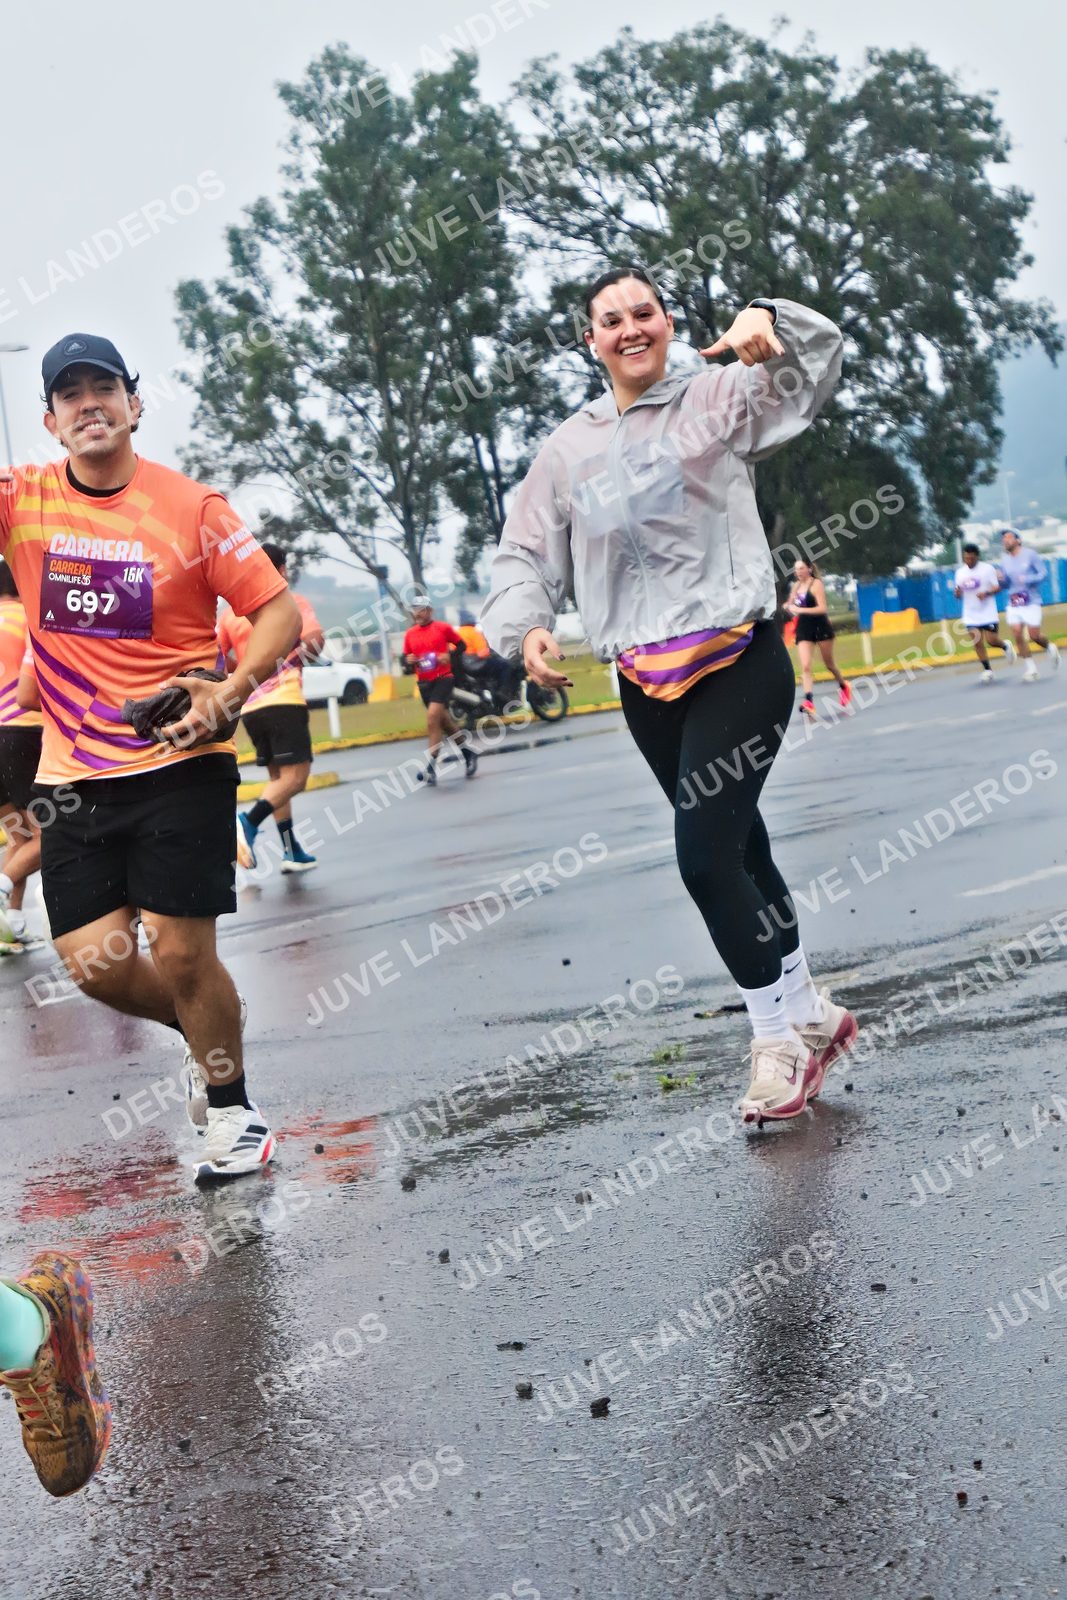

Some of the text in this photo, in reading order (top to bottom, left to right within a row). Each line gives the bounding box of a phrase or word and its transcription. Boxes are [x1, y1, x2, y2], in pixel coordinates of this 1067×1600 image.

[49, 533, 143, 562] CARRERA
[49, 559, 92, 576] CARRERA
[123, 567, 145, 583] 15K
[66, 589, 115, 615] 697
